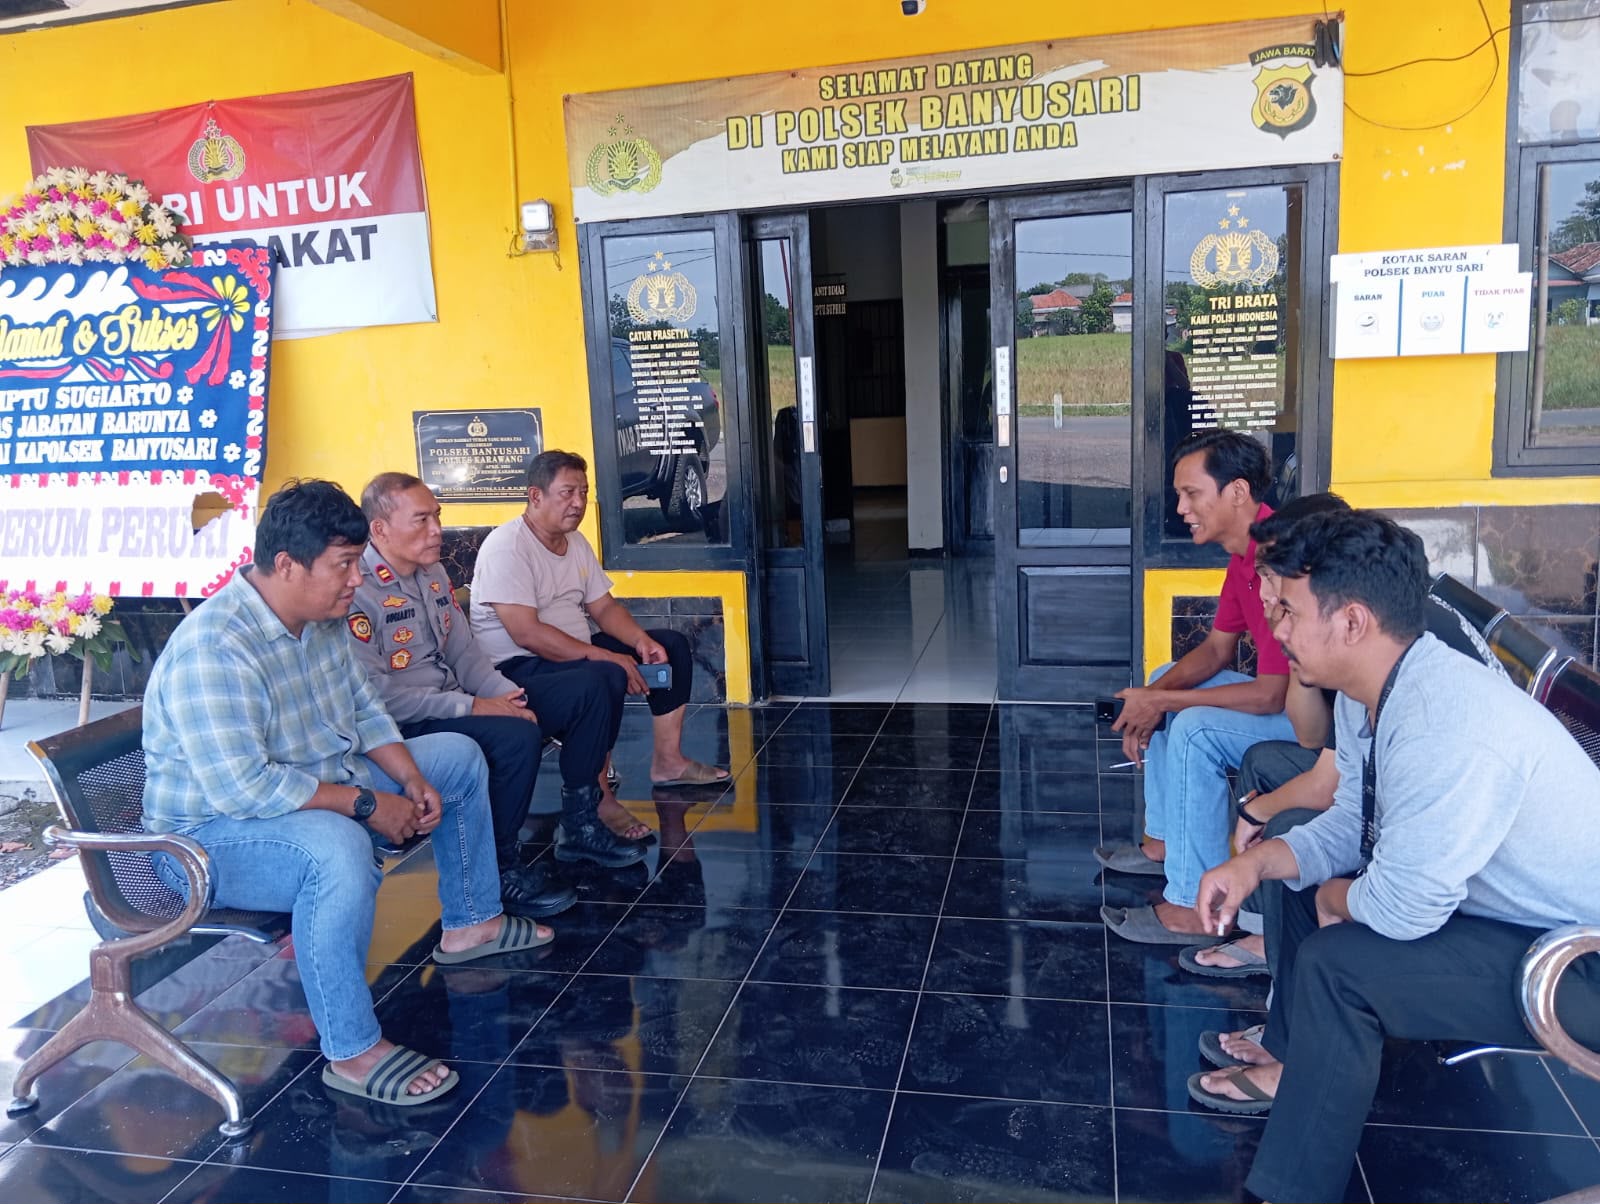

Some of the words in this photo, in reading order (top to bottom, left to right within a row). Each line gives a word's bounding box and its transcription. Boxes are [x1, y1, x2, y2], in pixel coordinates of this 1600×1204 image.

[1254, 48, 1282, 63] JAWA
[819, 64, 928, 101] SELAMAT
[935, 53, 1033, 90] DATANG
[726, 114, 764, 151] DI
[775, 97, 909, 146] POLSEK
[920, 73, 1141, 131] BANYUSARI
[781, 146, 838, 175] KAMI
[843, 138, 895, 168] SIAP
[900, 127, 1009, 164] MELAYANI
[1013, 121, 1078, 152] ANDA
[216, 171, 373, 222] UNTUK
[1382, 253, 1424, 265] KOTAK
[1427, 251, 1468, 262] SARAN
[1364, 266, 1410, 278] POLSEK
[1413, 264, 1452, 275] BANYU
[1456, 263, 1484, 274] SARI
[1354, 293, 1383, 302] SARAN
[1474, 288, 1501, 297] TIDAK
[1209, 296, 1231, 310] TRI
[1234, 293, 1278, 308] BRATA
[1190, 314, 1210, 326] KAMI
[1211, 313, 1236, 324] POLISI
[1237, 310, 1278, 322] INDONESIA
[101, 304, 200, 356] Sukses
[629, 330, 652, 342] CATUR
[653, 328, 689, 341] PRASETYA
[55, 383, 172, 410] SUGIARTO
[17, 412, 97, 438] JABATAN
[100, 409, 191, 434] BARUNYA
[15, 438, 104, 464] KAPOLSEK
[111, 437, 219, 462] BANYUSARI
[429, 447, 470, 457] POLSEK
[472, 446, 531, 456] BANYUSARI
[474, 455, 523, 464] KARAWANG
[0, 507, 91, 558] ERUM
